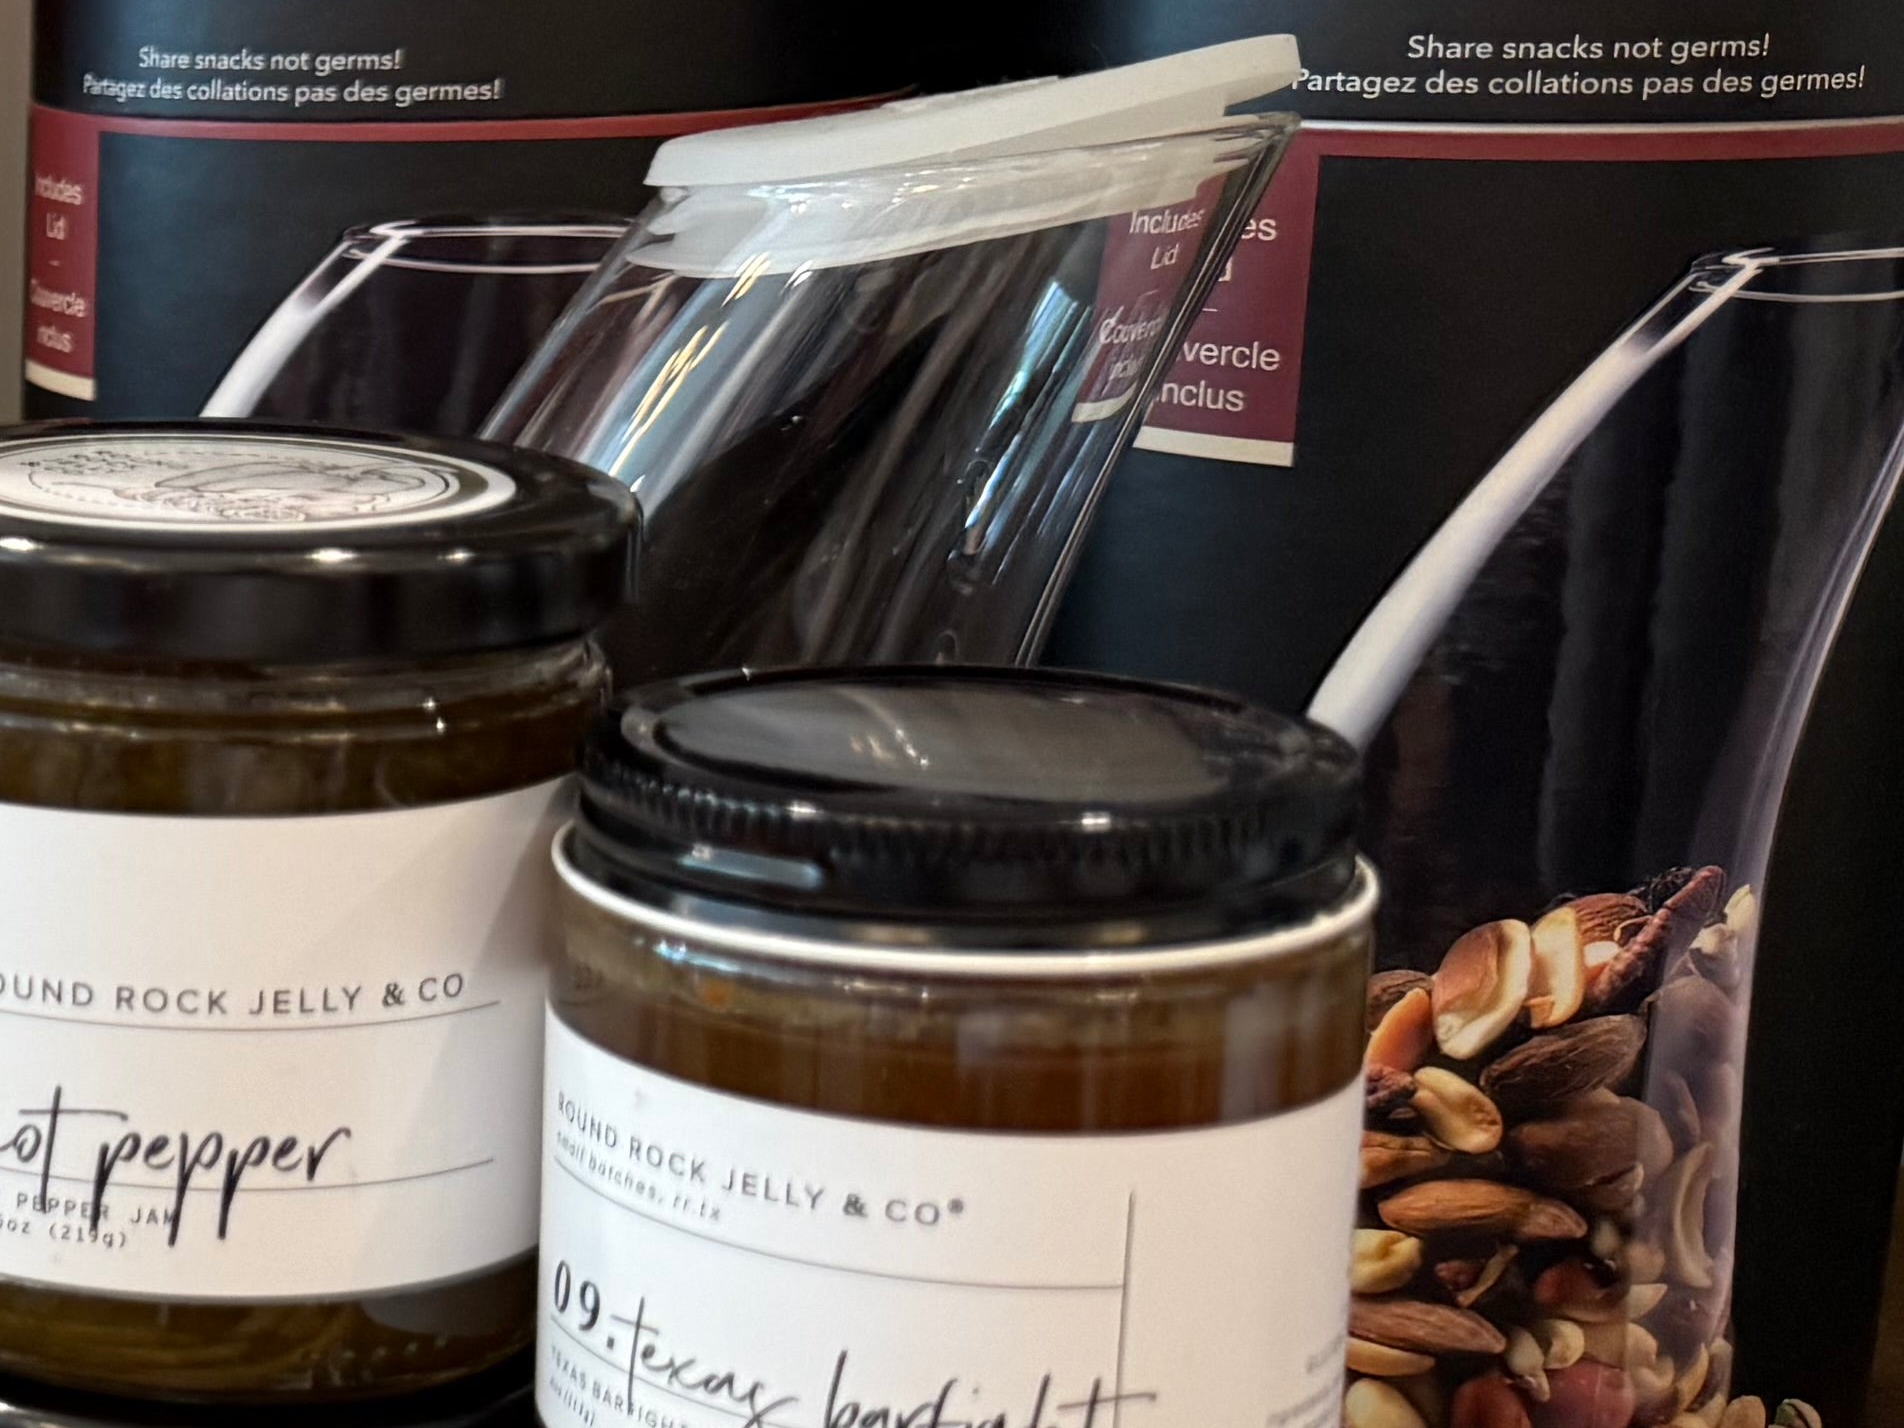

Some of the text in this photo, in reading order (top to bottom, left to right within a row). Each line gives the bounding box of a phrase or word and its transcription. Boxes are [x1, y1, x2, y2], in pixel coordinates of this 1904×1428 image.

[138, 45, 404, 78] Share snacks not germs!
[1406, 32, 1771, 66] Share snacks not germs!
[148, 77, 183, 102] des
[185, 78, 288, 104] collations
[294, 83, 338, 108] pas
[343, 78, 389, 104] des
[394, 78, 503, 108] germes!
[1424, 69, 1480, 96] des
[1487, 70, 1635, 96] collations
[1640, 74, 1695, 100] pas
[1701, 68, 1754, 95] des
[1759, 65, 1867, 100] germes!
[1182, 340, 1281, 372] vercle
[1158, 380, 1248, 413] nclus
[116, 982, 229, 1016] ROCK
[248, 983, 364, 1016] JELLY
[380, 980, 406, 1007] &
[418, 973, 465, 1003] CO
[558, 1090, 618, 1150] ROUND
[628, 1134, 707, 1184] ROCK
[719, 1165, 826, 1212] JELLY
[842, 1192, 868, 1219] &
[91, 1124, 353, 1248] pepper
[15, 1190, 110, 1222] PEPPER
